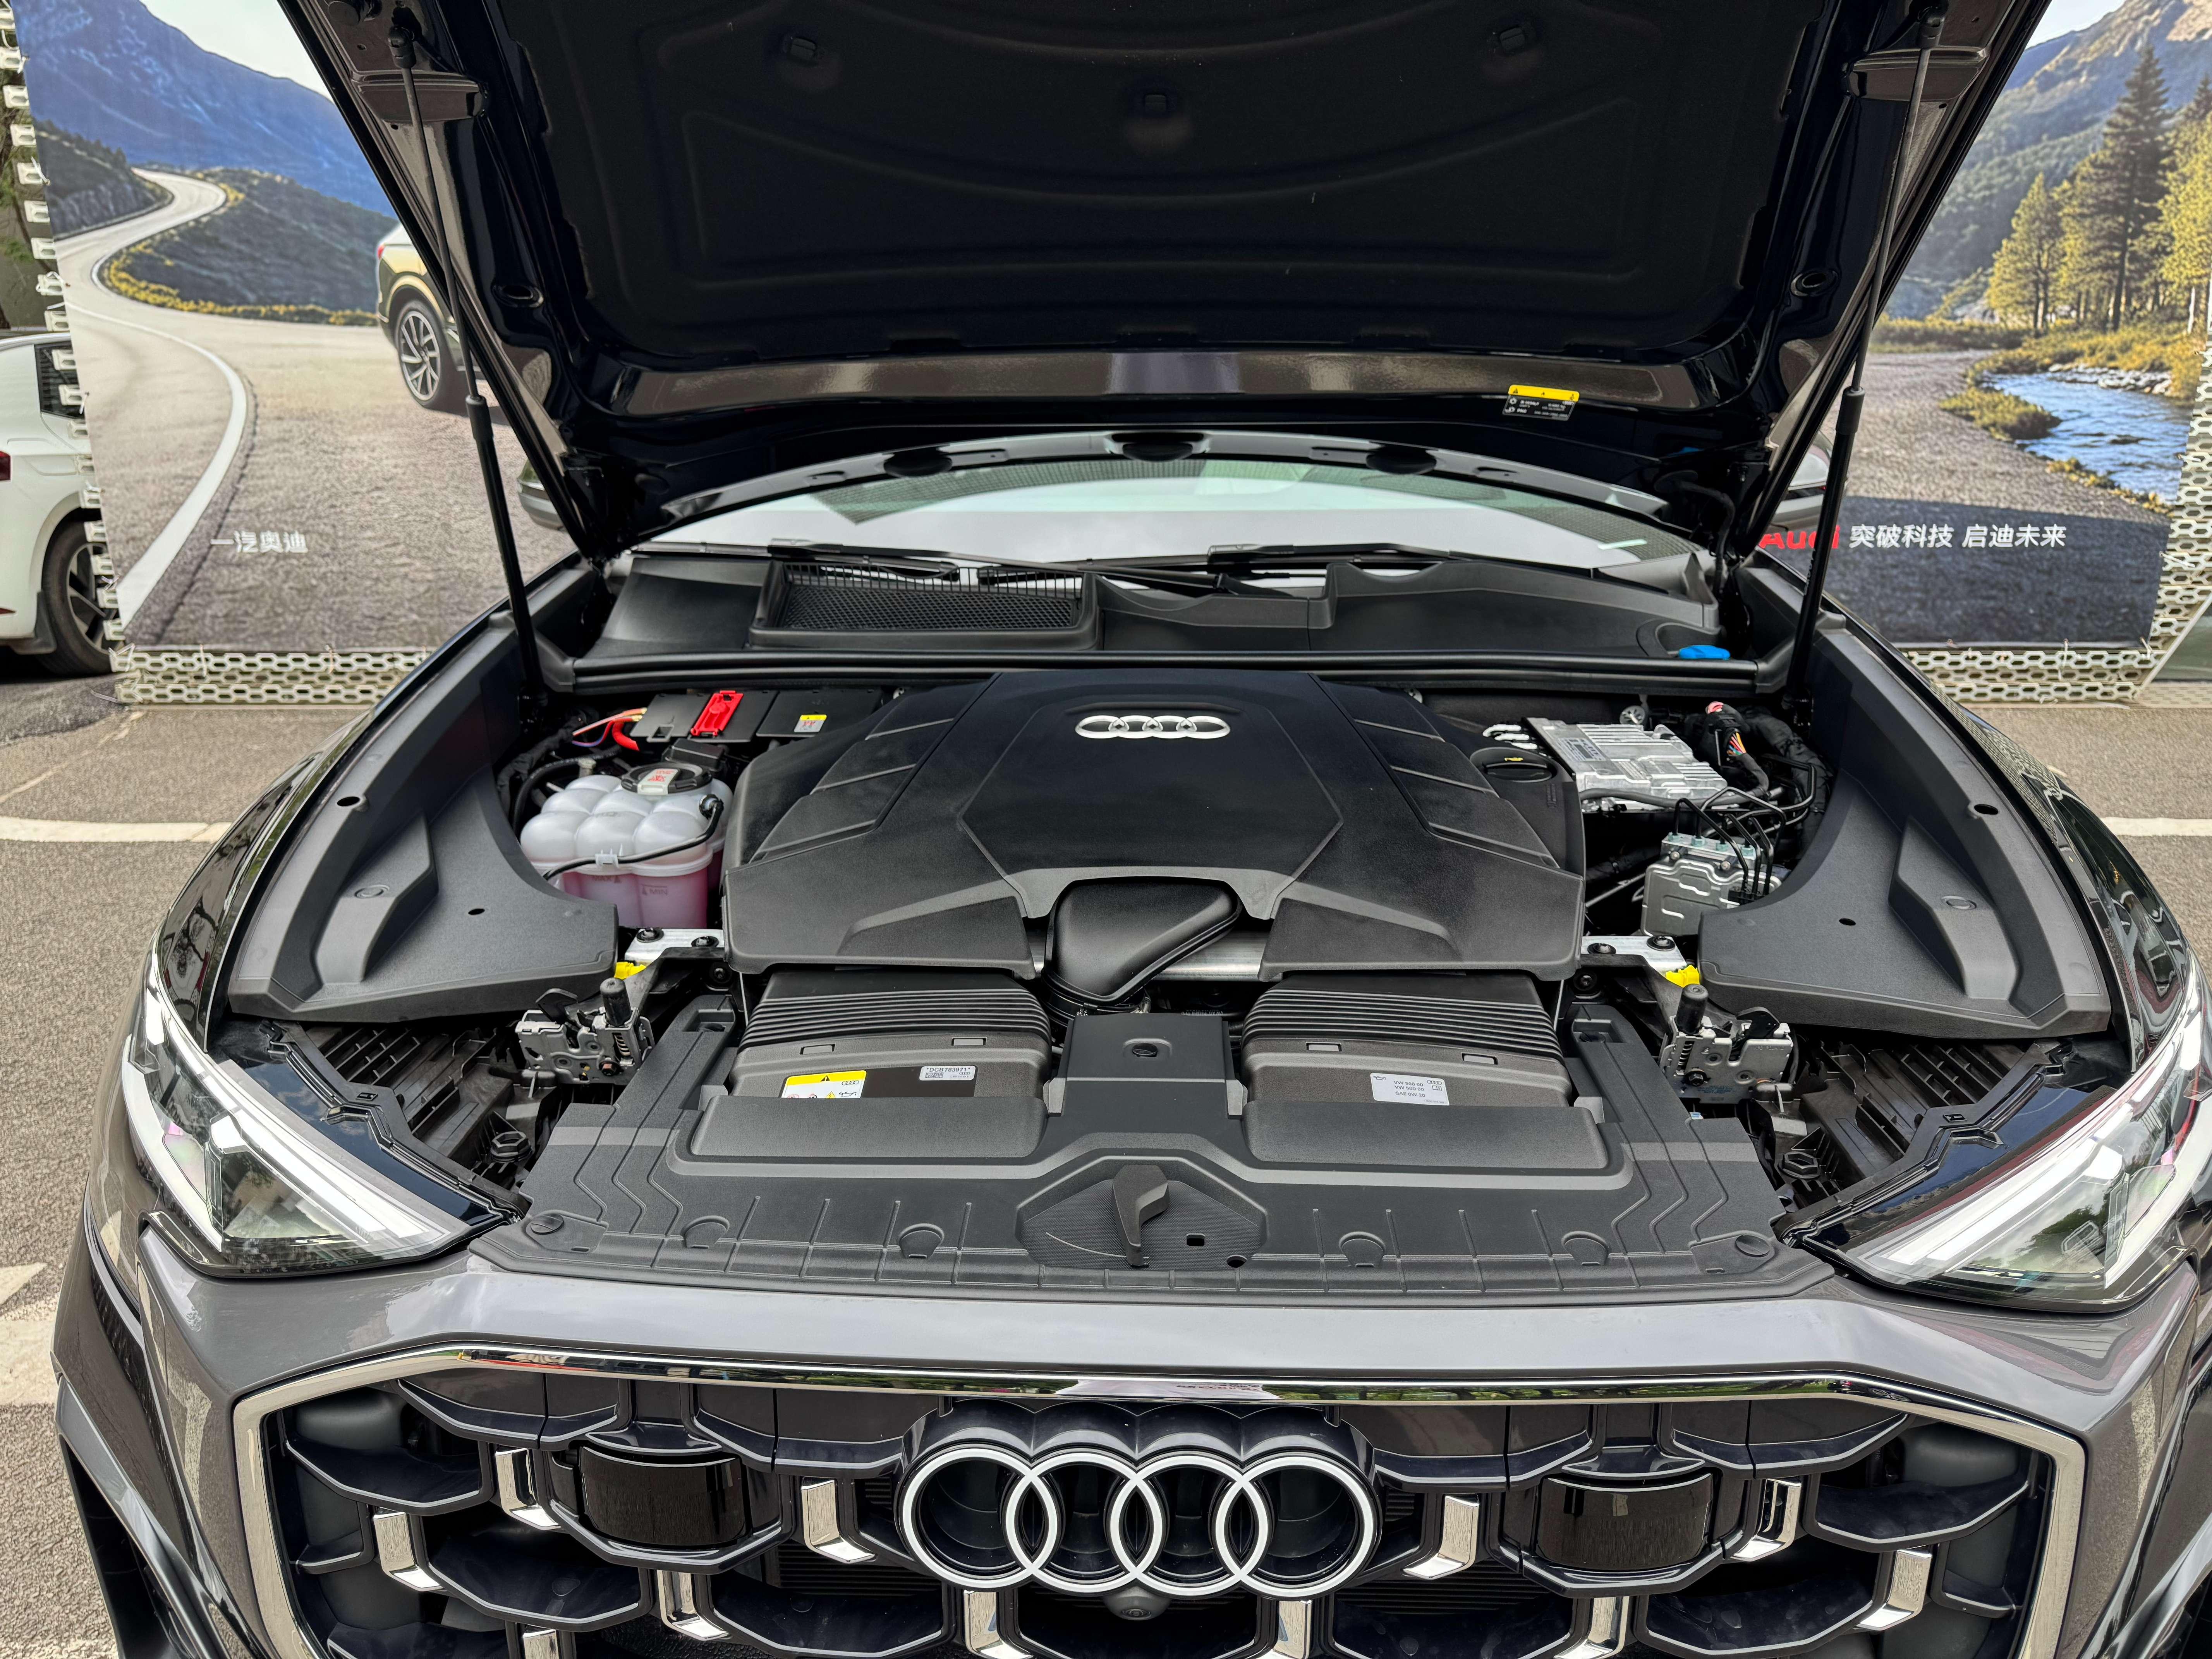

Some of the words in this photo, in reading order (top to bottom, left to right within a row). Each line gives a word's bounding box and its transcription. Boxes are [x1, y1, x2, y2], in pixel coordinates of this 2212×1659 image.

[210, 530, 308, 553] 一汽奥迪
[1850, 524, 1953, 548] 突破科技
[1962, 524, 2067, 548] 启迪未来
